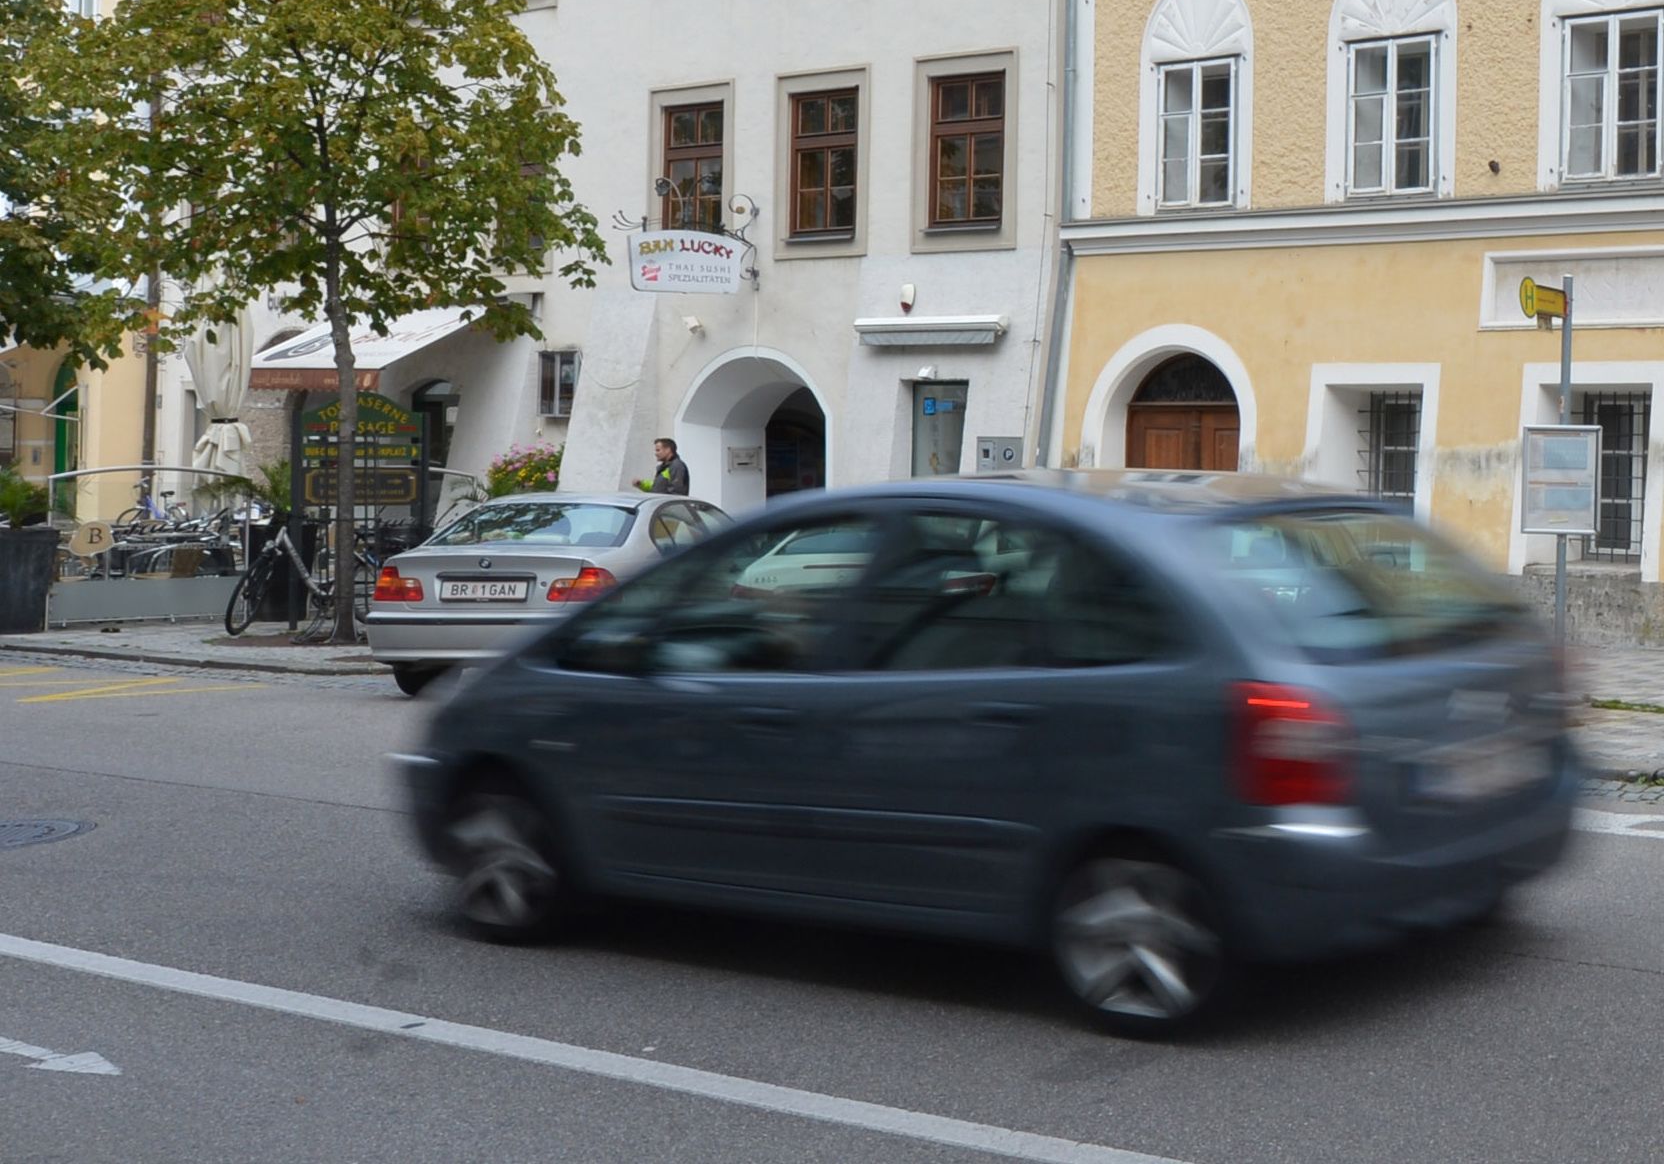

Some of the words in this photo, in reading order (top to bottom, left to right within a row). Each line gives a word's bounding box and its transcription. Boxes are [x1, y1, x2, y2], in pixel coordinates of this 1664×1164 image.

[680, 239, 734, 260] LUCKY
[668, 262, 696, 273] THAI
[700, 264, 731, 274] SUSHI
[330, 420, 396, 434] PSAGE
[88, 527, 103, 544] B
[451, 584, 469, 596] BR
